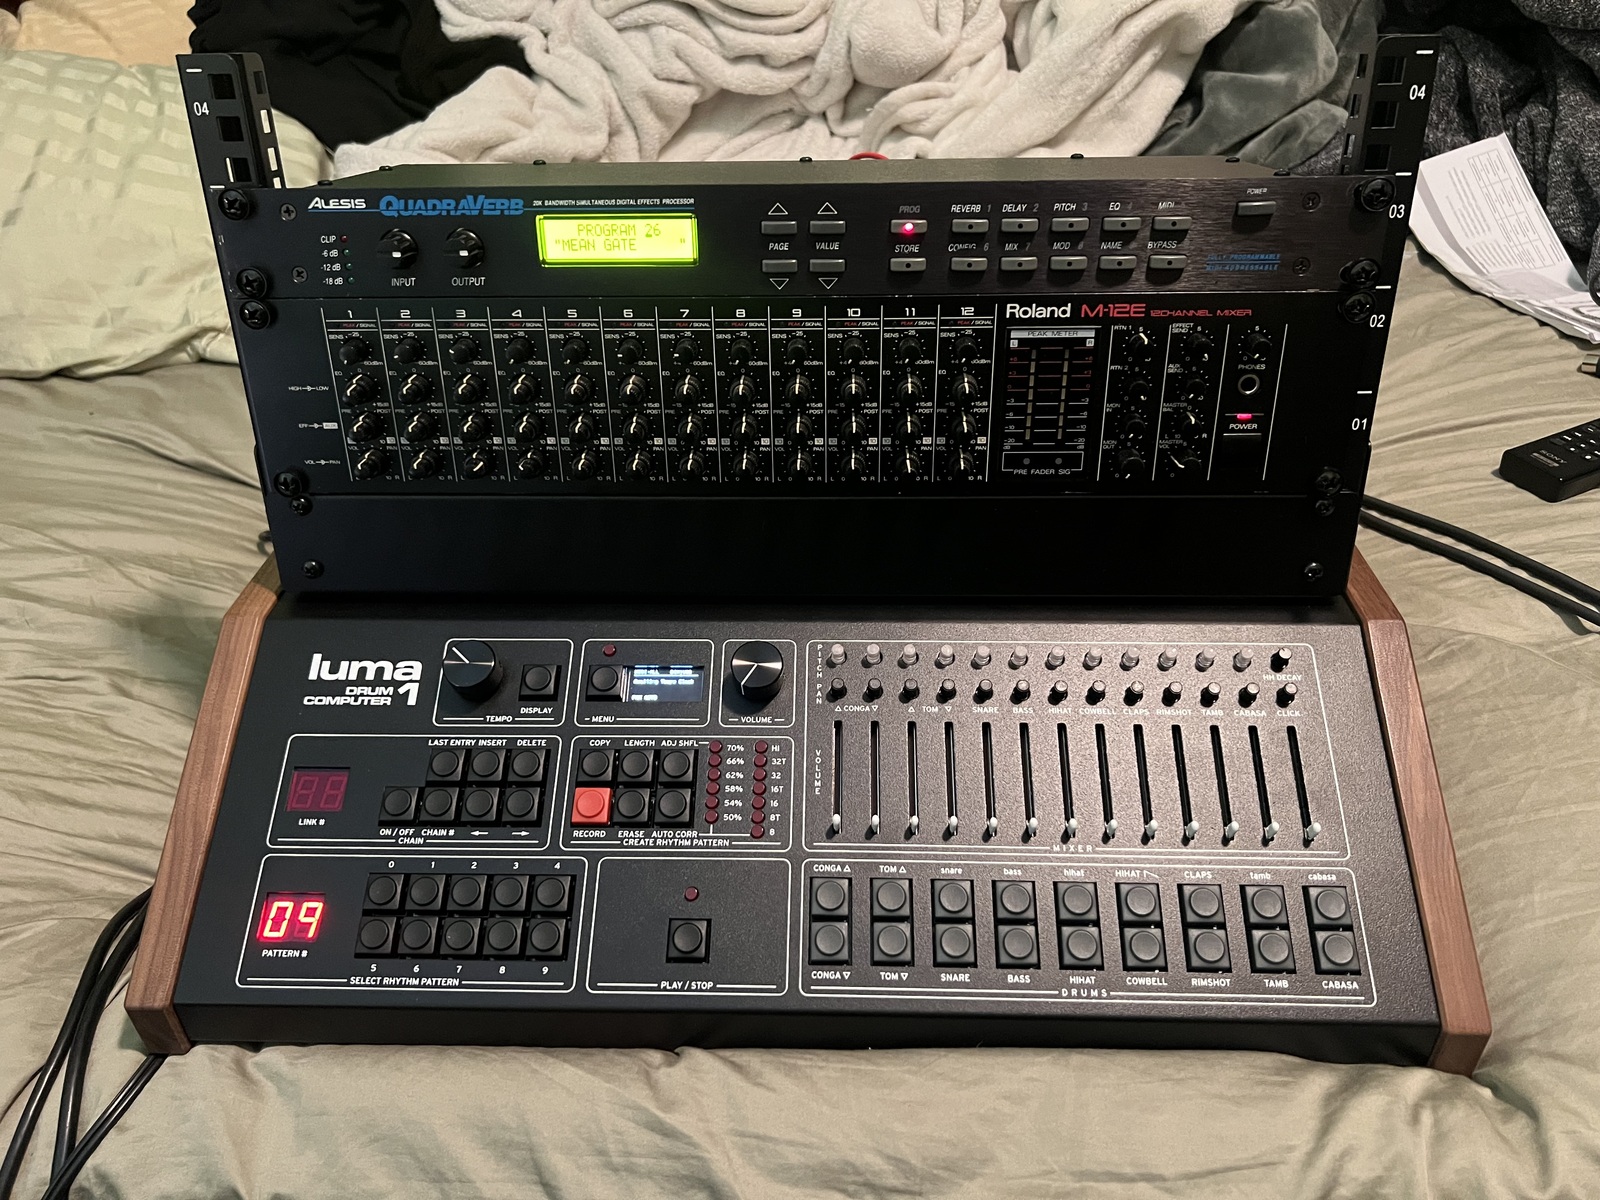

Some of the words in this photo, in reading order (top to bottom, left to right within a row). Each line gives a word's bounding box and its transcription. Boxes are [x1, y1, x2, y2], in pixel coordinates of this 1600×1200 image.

[1409, 84, 1426, 101] 04
[194, 102, 209, 116] 04
[308, 197, 366, 209] ALESIS
[1053, 203, 1076, 211] PITCH
[899, 205, 920, 213] PROG
[951, 204, 981, 212] REVERB
[1002, 203, 1027, 212] DELAY
[1388, 204, 1405, 219] 03
[577, 224, 636, 237] PROGRAM
[645, 224, 661, 238] 26
[320, 235, 336, 243] CLIP
[604, 239, 637, 251] GATE
[769, 242, 789, 250] PAGE
[816, 242, 839, 250] VALUE
[895, 244, 919, 253] STORE
[1005, 243, 1018, 251] MIX
[1053, 242, 1070, 250] MOD
[1147, 241, 1177, 249] BYPASS
[329, 249, 338, 257] dB
[391, 278, 416, 286] INPUT
[452, 276, 485, 286] OUTPUT
[348, 310, 352, 318] 1
[400, 310, 411, 318] 2
[456, 310, 466, 318] 3
[512, 309, 522, 318] 4
[567, 309, 577, 318] 5
[624, 309, 633, 317] 6
[680, 309, 689, 317] 7
[736, 309, 745, 317] 8
[792, 309, 802, 317] 9
[847, 308, 860, 316] 10
[905, 308, 916, 316] 11
[961, 307, 974, 315] 12
[1006, 303, 1071, 319] Roland
[1081, 304, 1146, 317] M-12E
[1369, 314, 1386, 328] 02
[1351, 418, 1368, 431] 01
[308, 653, 422, 680] luma
[346, 686, 394, 695] DRUM
[397, 683, 420, 706] 1
[303, 696, 392, 706] COMPUTER
[1184, 871, 1212, 879] CLAPS
[263, 901, 324, 938] 09
[301, 950, 308, 958] #
[370, 964, 376, 972] 5
[499, 966, 506, 974] 8
[542, 966, 548, 974] 9
[880, 972, 898, 980] TOM
[941, 974, 970, 982] SNARE
[1008, 975, 1030, 983] BASS
[1070, 976, 1095, 984] HIHAT
[350, 977, 382, 985] SELECT
[383, 977, 419, 985] RHYTHM
[421, 978, 459, 986] PATTERN
[661, 981, 683, 989] PLAY
[691, 982, 713, 990] STOP
[1126, 978, 1168, 986] COWBELL
[1191, 978, 1230, 986] RIMSHOT
[1264, 980, 1288, 988] TAMB
[1322, 981, 1358, 989] CABASA
[1062, 988, 1108, 997] DRUMS
